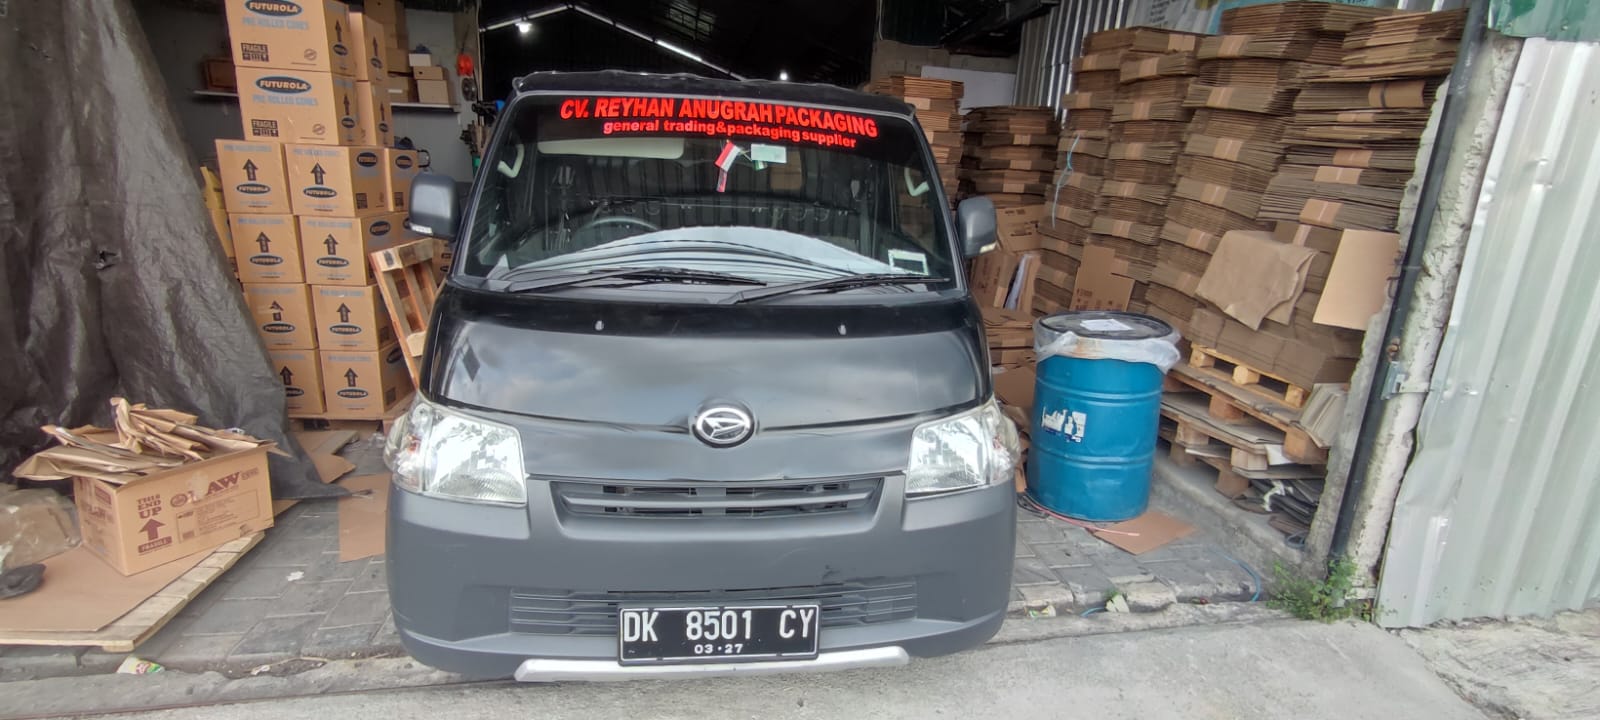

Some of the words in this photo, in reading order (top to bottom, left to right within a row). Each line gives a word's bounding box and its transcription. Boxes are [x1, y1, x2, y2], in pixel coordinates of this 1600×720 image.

[249, 2, 299, 13] FUTUROLA
[242, 44, 267, 53] FRAGILE
[260, 80, 309, 90] FUTUROLA
[560, 98, 589, 120] CV.
[594, 97, 675, 118] REYHAN
[679, 97, 774, 124] ANUGRAH
[774, 103, 878, 138] PACKAGING
[252, 120, 277, 129] FRAGILE
[603, 119, 660, 135] general
[801, 130, 857, 148] supplier
[137, 494, 161, 505] THIS
[137, 500, 162, 511] END
[138, 507, 162, 519] UP
[623, 611, 659, 642] DK
[686, 610, 752, 641] 8501
[779, 609, 815, 639] CY
